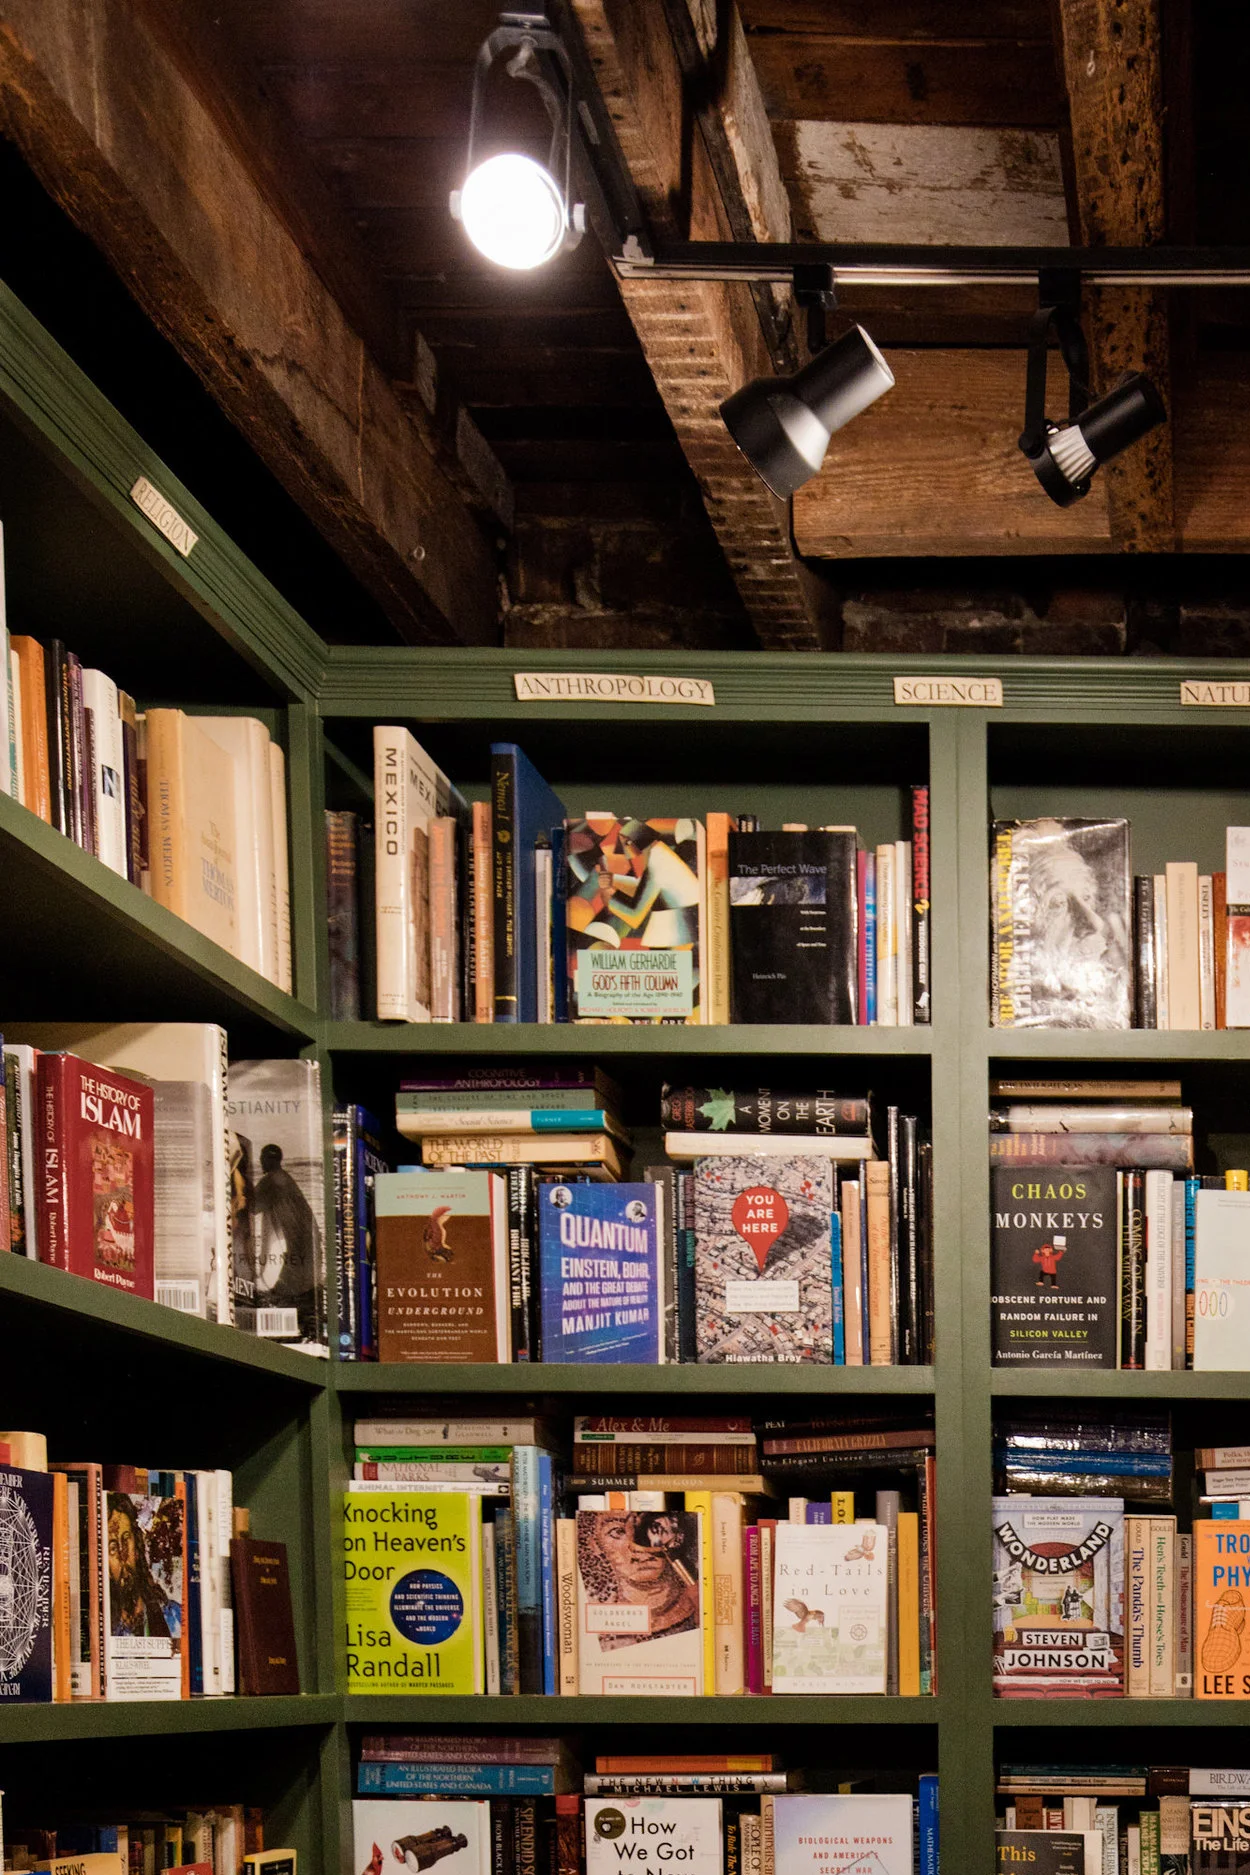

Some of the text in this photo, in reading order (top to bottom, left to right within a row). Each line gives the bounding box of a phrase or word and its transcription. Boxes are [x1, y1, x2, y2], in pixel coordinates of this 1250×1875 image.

[134, 481, 197, 552] RELIGION
[519, 677, 711, 699] ANTHROPOLOGY
[901, 682, 997, 702] SCIENCE
[385, 747, 399, 856] MEXICO
[913, 789, 930, 915] MAD SCIENCE 2
[80, 1074, 141, 1111] THE HISTORY OF
[80, 1092, 142, 1140] ISLAM
[739, 1105, 752, 1114] A
[759, 1088, 772, 1133] MOMENT
[777, 1101, 790, 1121] ON
[796, 1102, 810, 1121] THE
[816, 1089, 836, 1135] EARTH
[746, 1195, 775, 1206] YOU
[1011, 1183, 1088, 1200] CHAOS
[746, 1209, 774, 1219] ARE
[995, 1211, 1104, 1229] MONKEYS
[560, 1212, 648, 1254] QUANTUM
[742, 1222, 779, 1233] HERE
[561, 1257, 651, 1280] EINSTEIN, BOHR,
[387, 1287, 483, 1297] EVOLUTION
[991, 1296, 1107, 1305] OBSCENE FORTUNE AND
[387, 1307, 484, 1315] UNDERGROUND
[1000, 1312, 1098, 1322] RANDOM FAILURE IN
[562, 1308, 650, 1336] MANJIT KUMAR
[1009, 1329, 1089, 1338] SILICON VALLEY
[725, 1353, 802, 1365] Hiawatha Bray
[343, 1531, 467, 1553] on Heaven's
[996, 1521, 1112, 1574] WONDERLAND
[344, 1560, 396, 1581] Door
[345, 1623, 392, 1648] Lisa
[1025, 1633, 1080, 1646] STEVEN
[346, 1652, 441, 1678] Randall
[1007, 1652, 1106, 1669] JOHNSON
[1202, 1675, 1235, 1695] LEE
[630, 1817, 677, 1835] How
[613, 1843, 695, 1861] We Got
[996, 1846, 1037, 1862] This
[1193, 1837, 1221, 1852] The
[1223, 1837, 1250, 1852] Life
